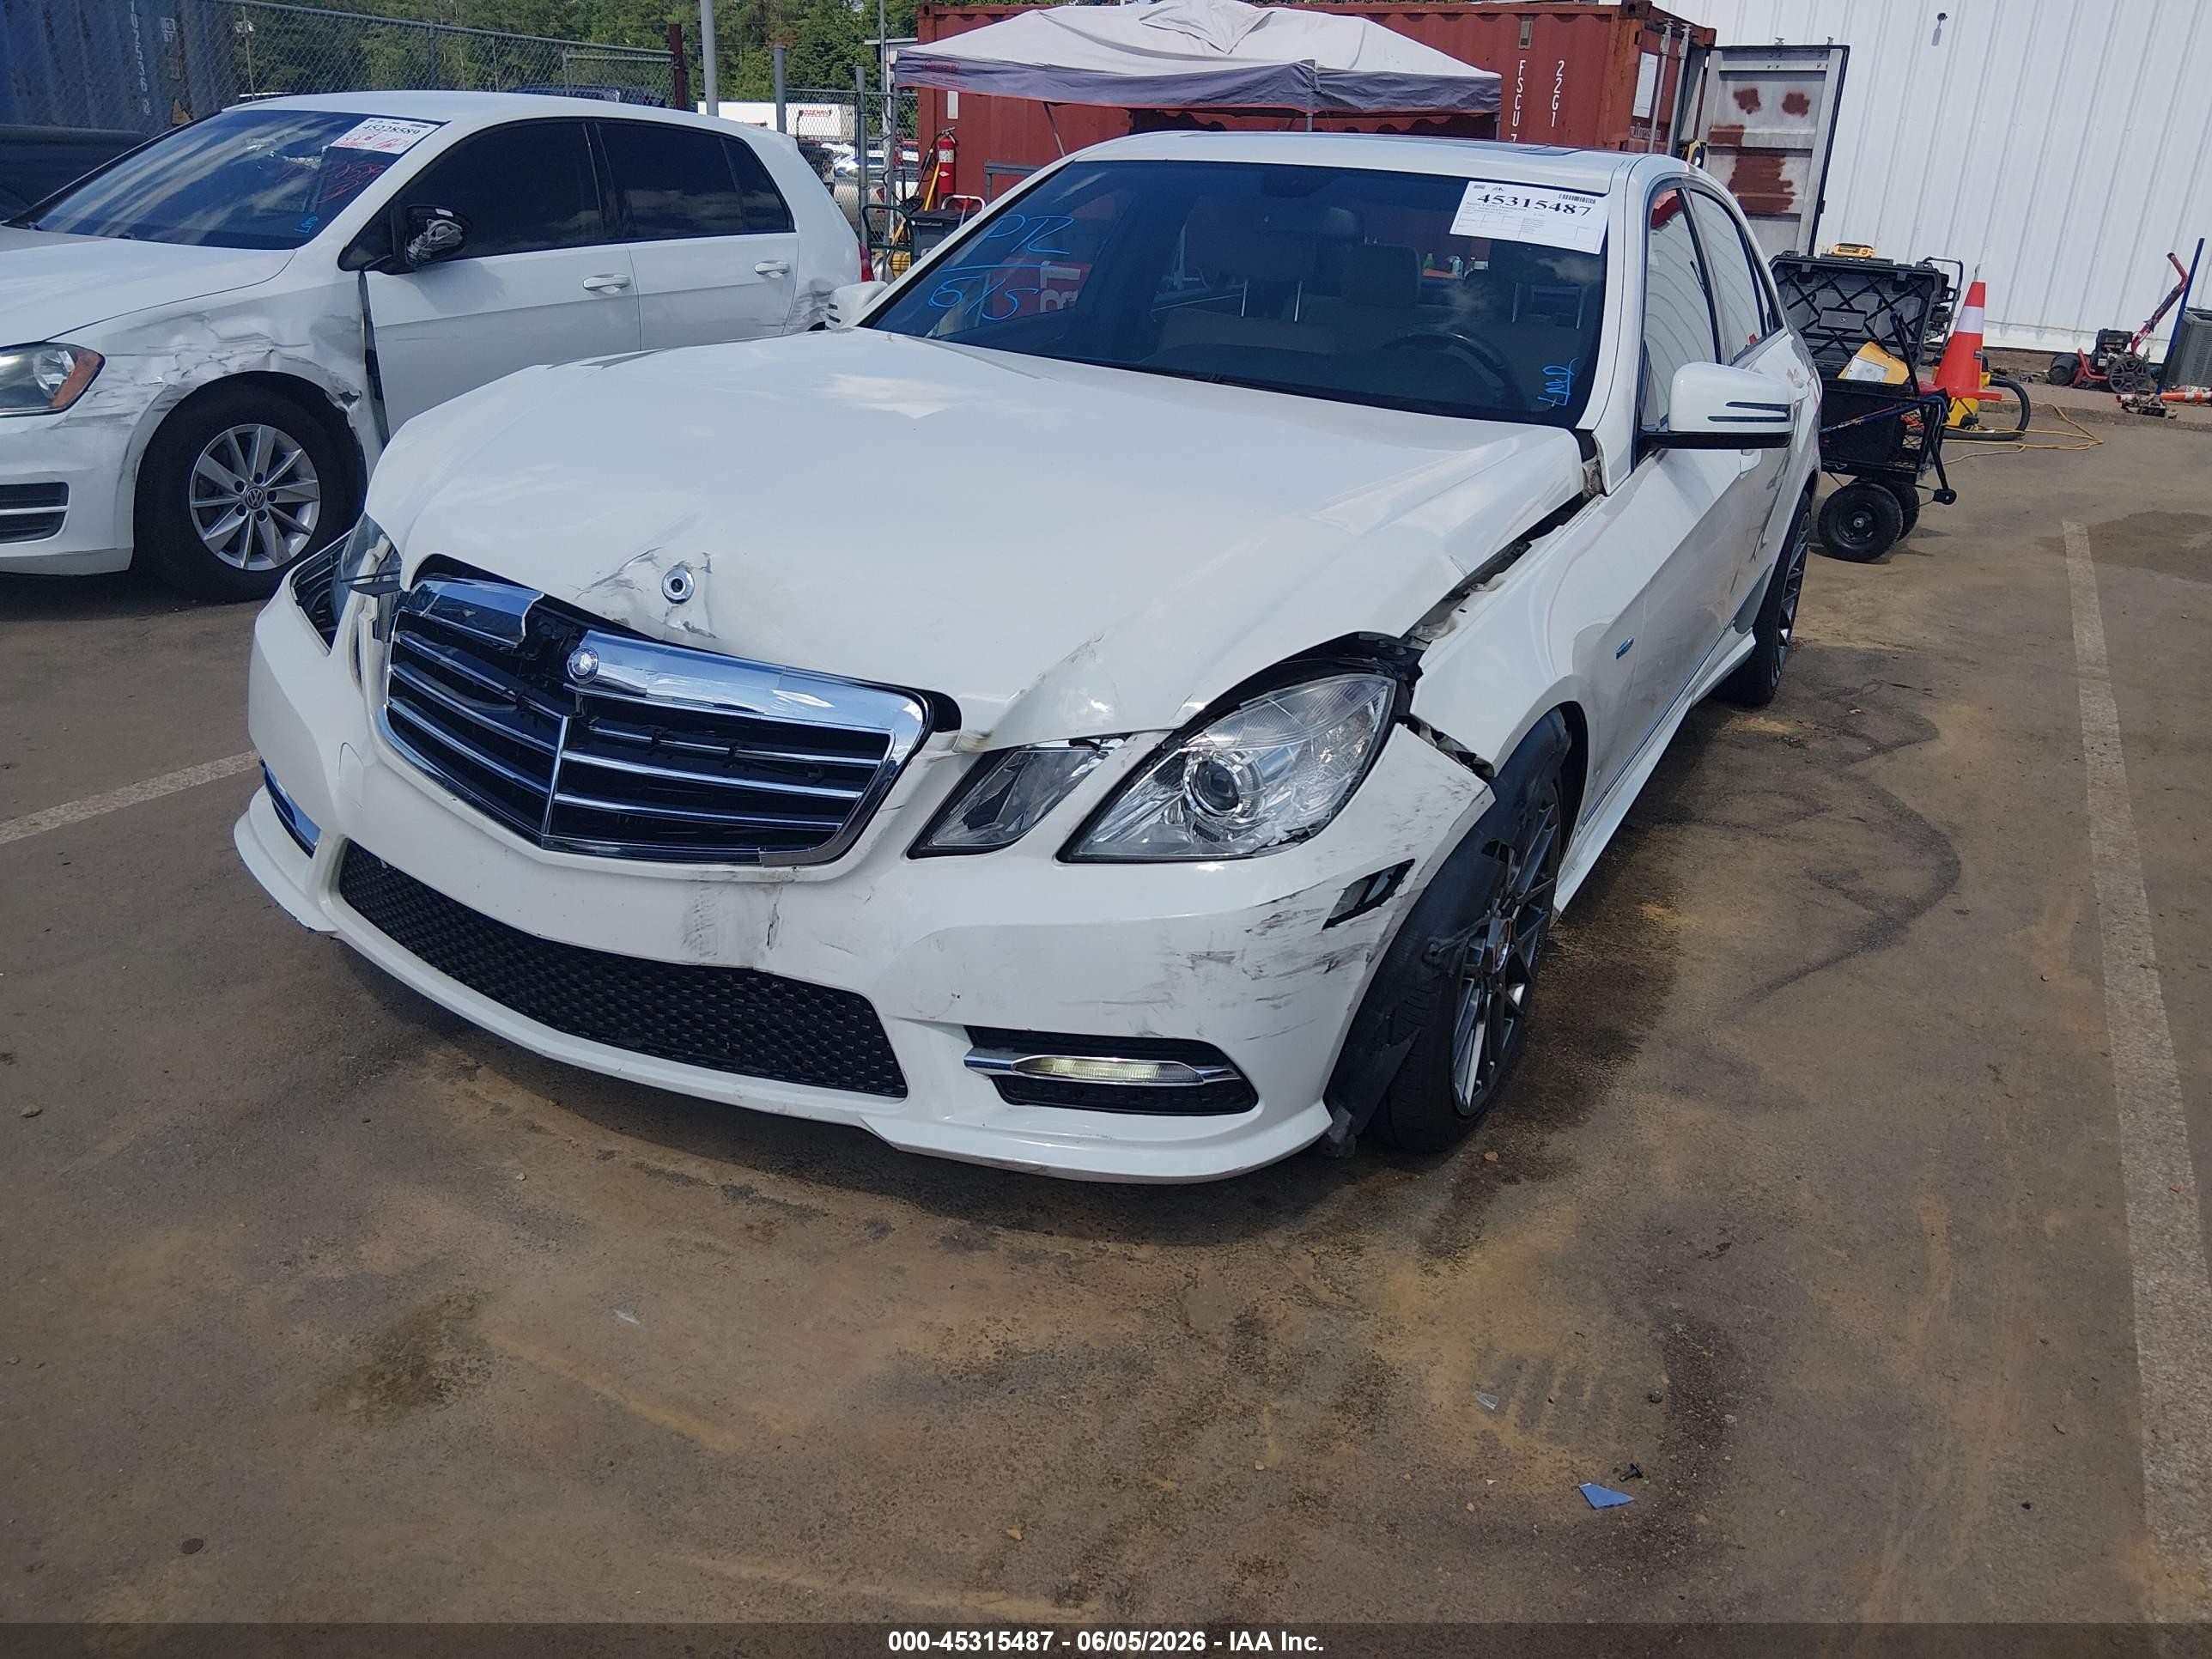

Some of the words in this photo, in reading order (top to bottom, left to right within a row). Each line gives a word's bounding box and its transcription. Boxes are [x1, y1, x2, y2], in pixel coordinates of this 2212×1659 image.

[1512, 60, 1526, 127] FSCU
[1552, 60, 1565, 128] 22G1
[1477, 193, 1592, 216] 45315487
